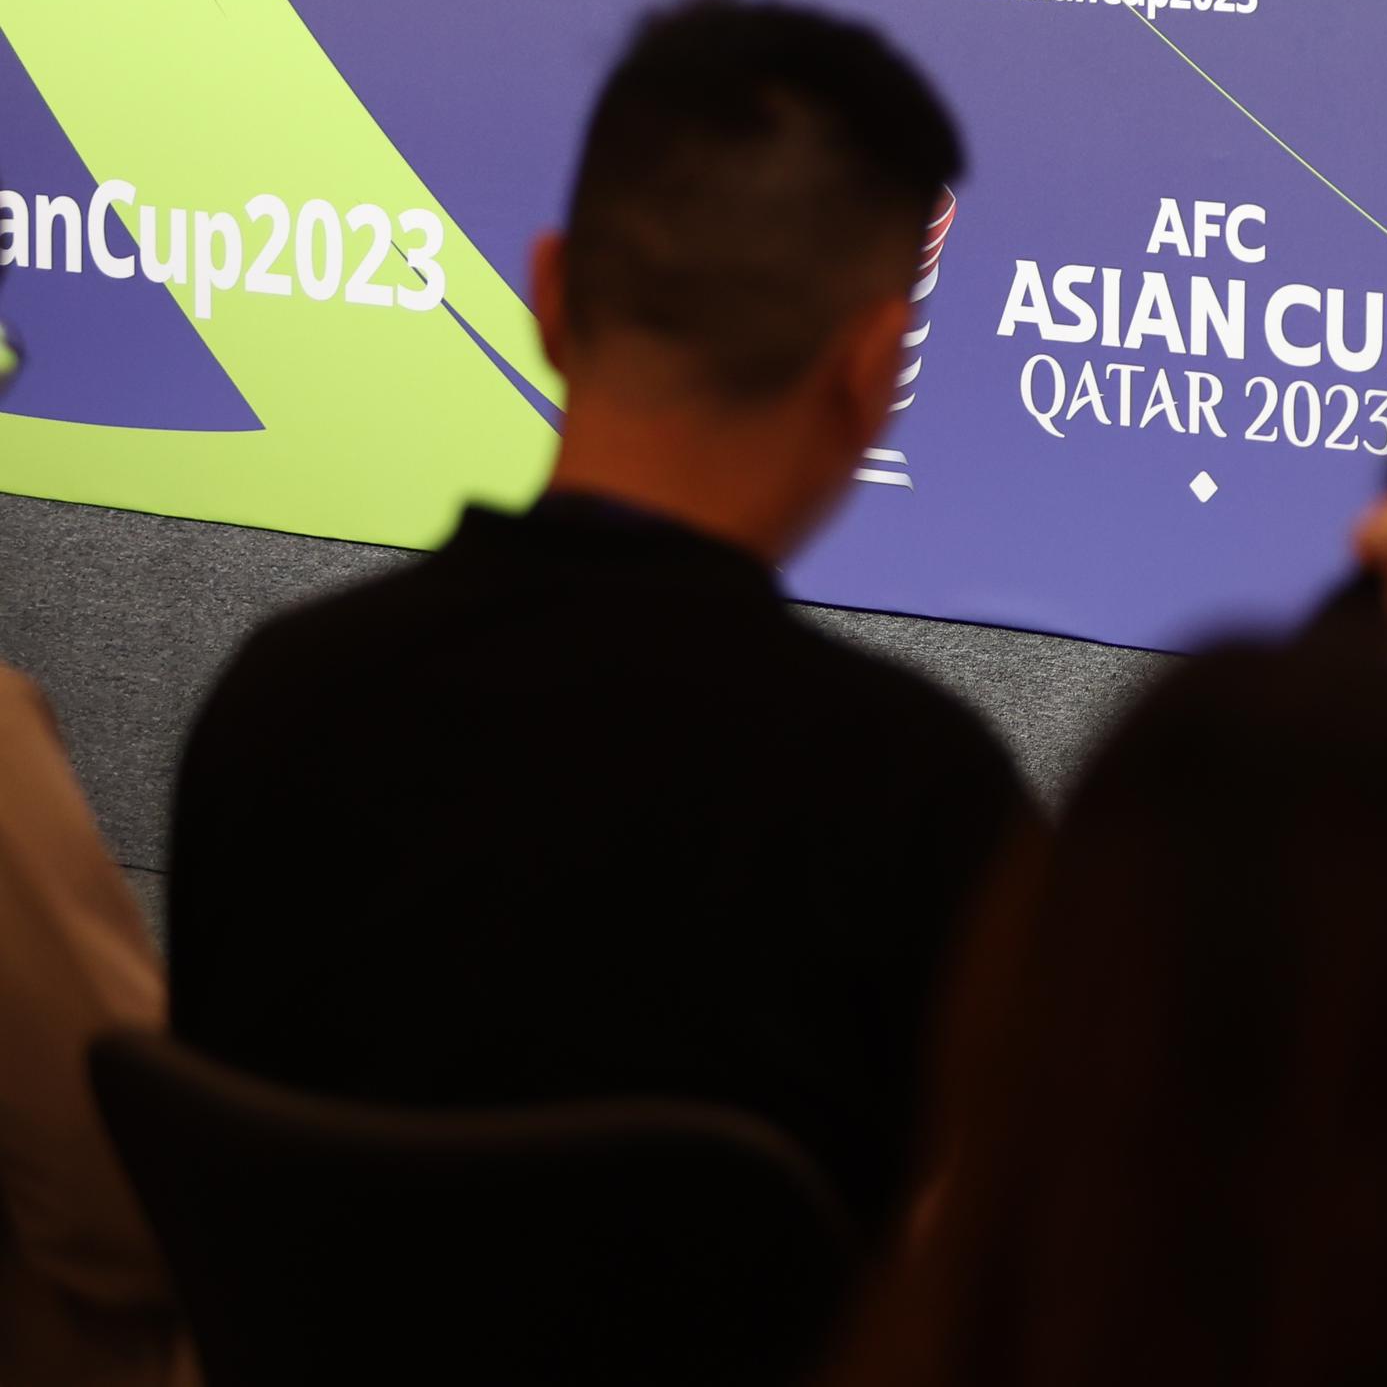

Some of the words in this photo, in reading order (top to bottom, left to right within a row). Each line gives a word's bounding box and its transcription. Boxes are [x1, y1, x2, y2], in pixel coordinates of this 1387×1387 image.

[1146, 198, 1265, 263] AFC
[997, 260, 1245, 359] ASIAN
[1021, 355, 1227, 437] QATAR
